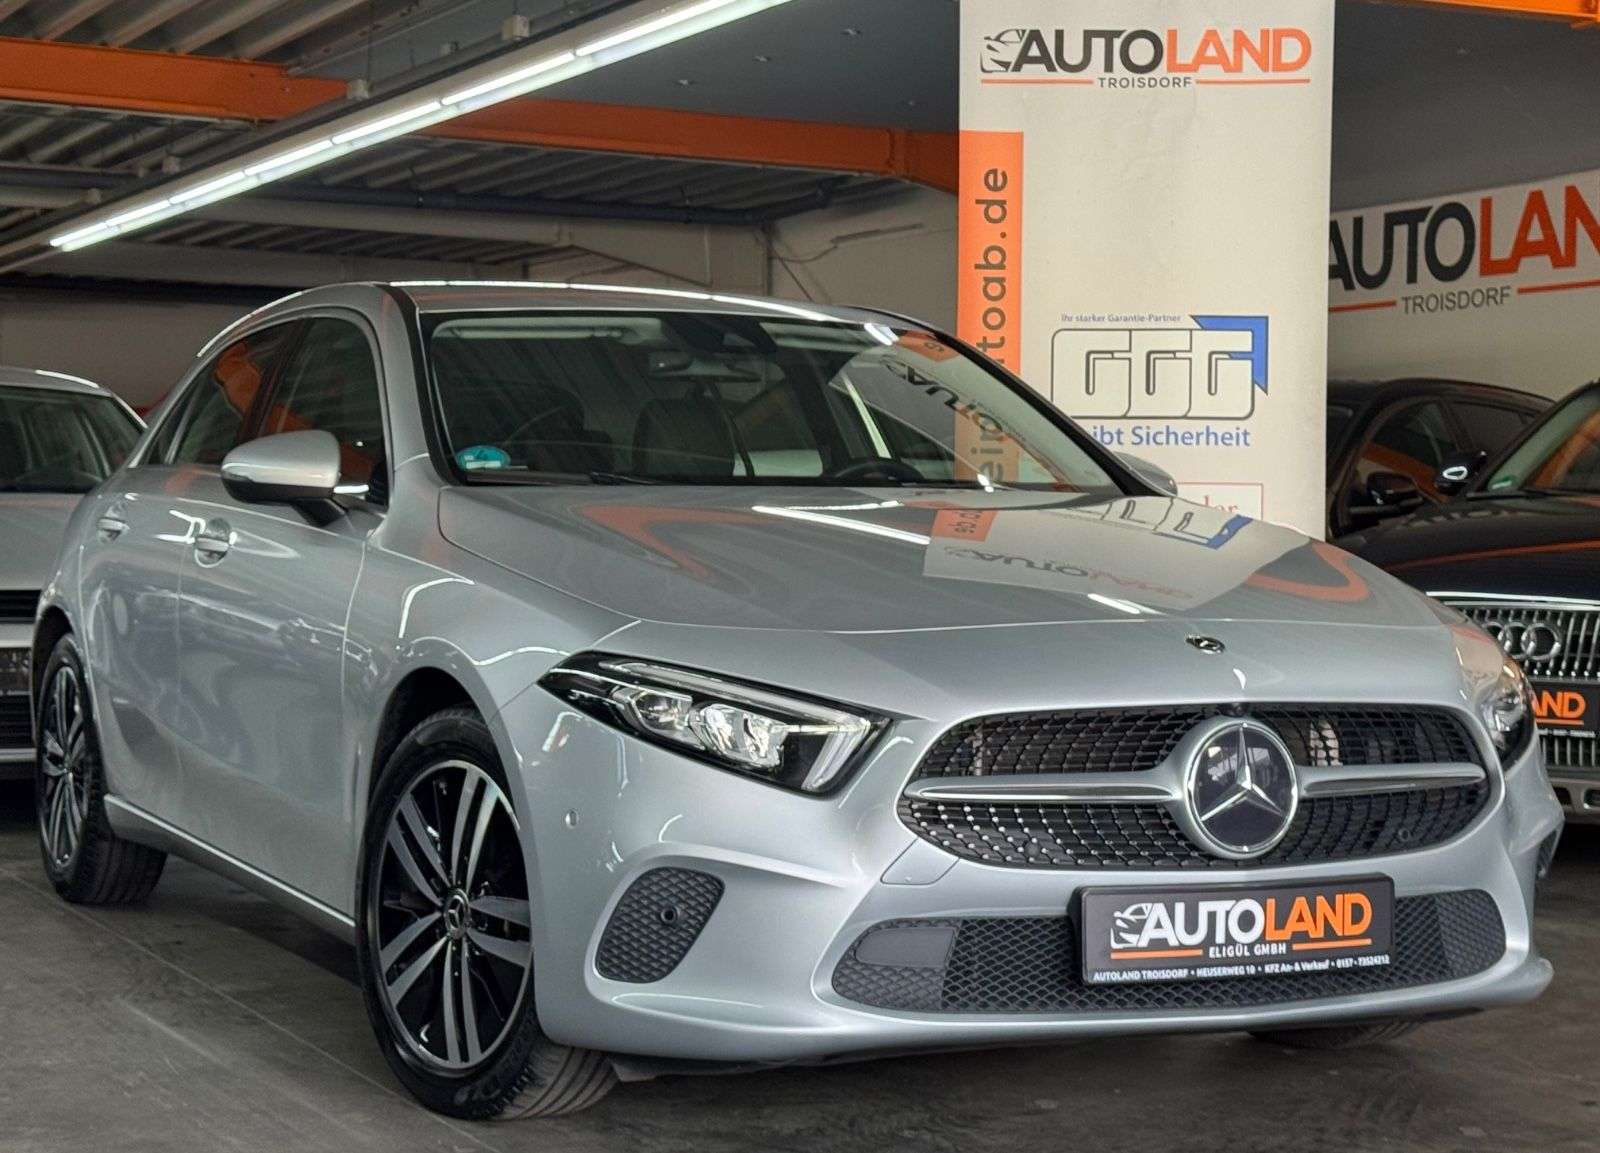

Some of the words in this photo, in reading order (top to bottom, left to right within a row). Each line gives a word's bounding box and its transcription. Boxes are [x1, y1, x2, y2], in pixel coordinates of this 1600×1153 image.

[1011, 27, 1312, 74] AUTOLAND
[1098, 77, 1192, 89] TROISDORF
[975, 167, 1008, 364] toab.de
[1402, 285, 1511, 315] TROISDORF
[1092, 427, 1124, 446] ibt
[1131, 425, 1251, 447] Sicherheit
[1136, 892, 1373, 947] AUTOLAND
[1254, 942, 1287, 956] GMBH
[1093, 969, 1140, 981] AUTOLAND
[1142, 968, 1188, 980] TROISDORF
